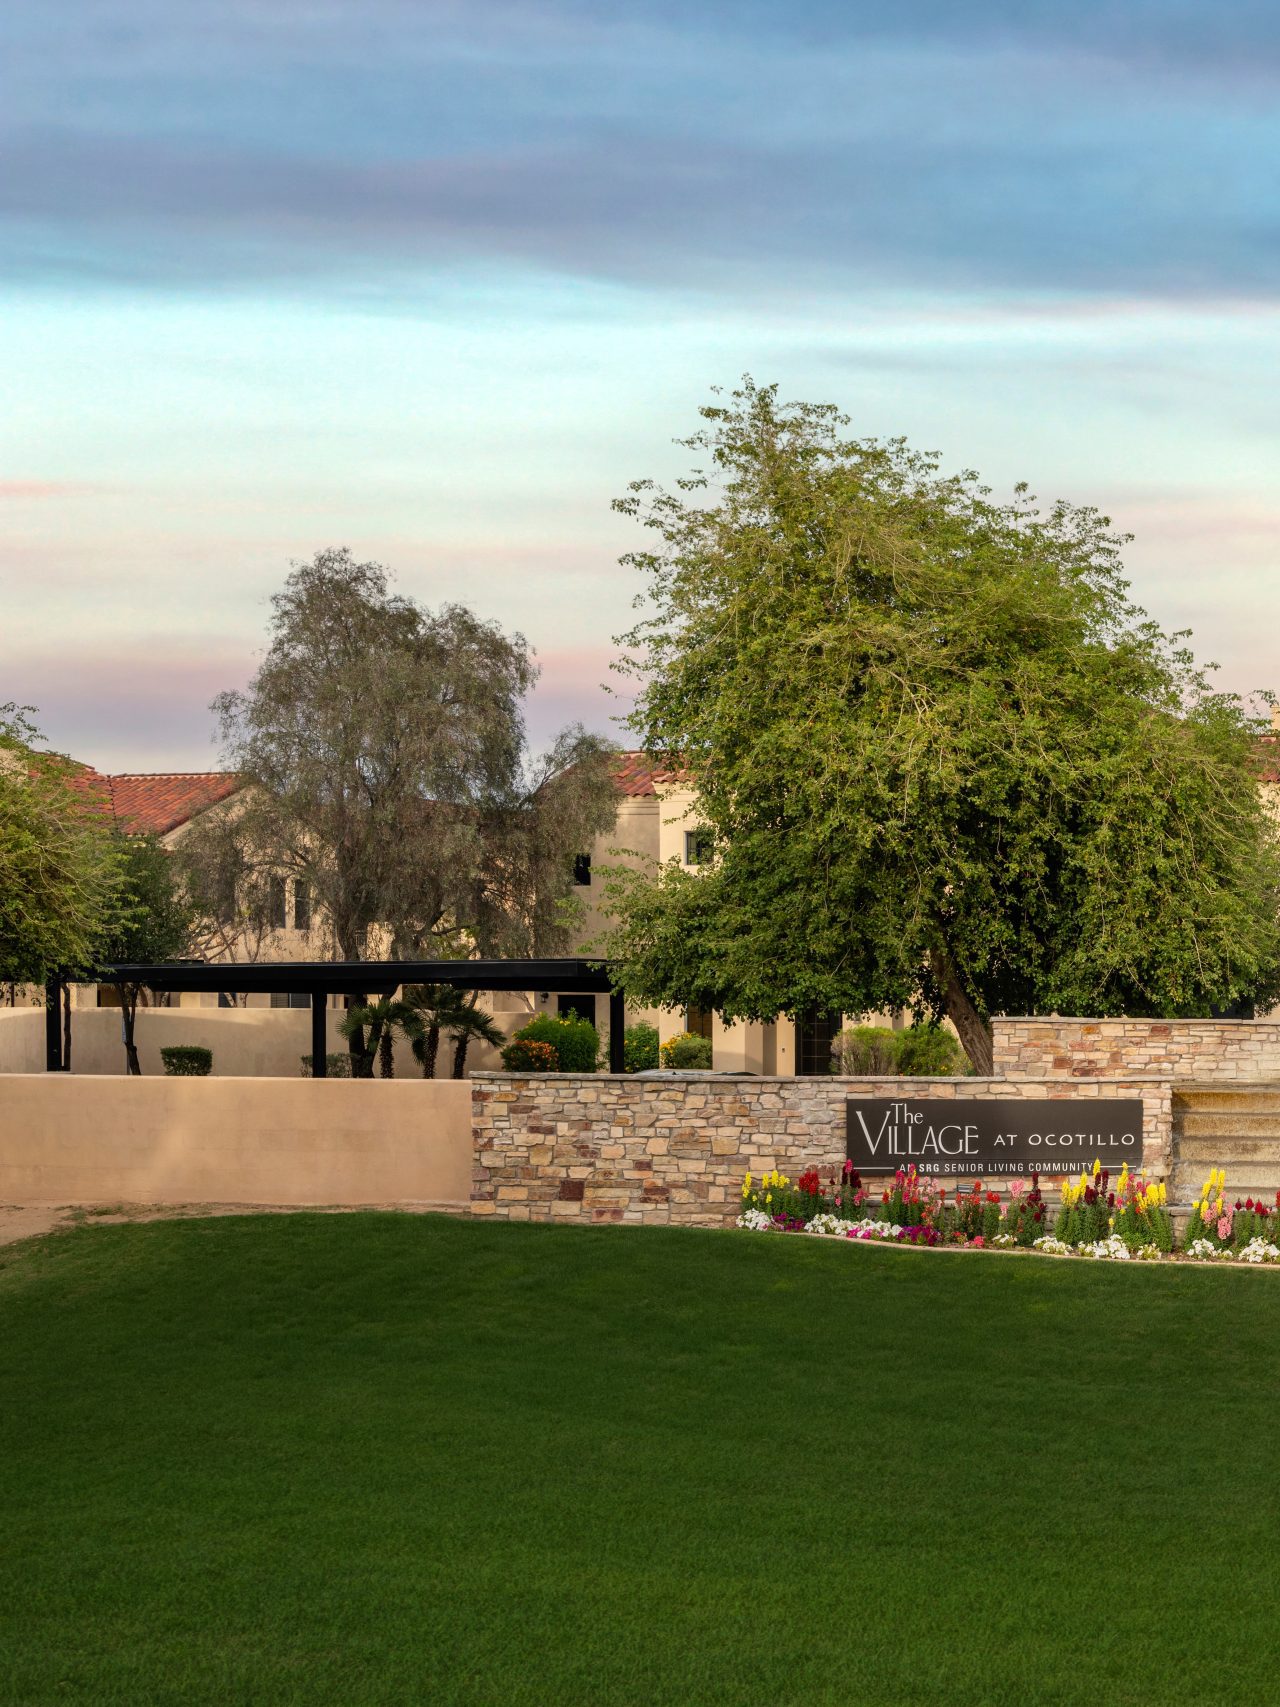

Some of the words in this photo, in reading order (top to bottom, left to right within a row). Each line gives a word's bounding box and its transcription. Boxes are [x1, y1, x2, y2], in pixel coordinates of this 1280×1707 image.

[891, 1102, 924, 1124] The
[855, 1110, 980, 1156] VILLAGE
[994, 1134, 1018, 1147] AT
[1028, 1133, 1135, 1146] OCOTILLO
[919, 1164, 940, 1173] SRG
[944, 1163, 984, 1173] SENIOR
[988, 1162, 1024, 1172] LIVING
[1028, 1162, 1093, 1172] COMMUNITY
